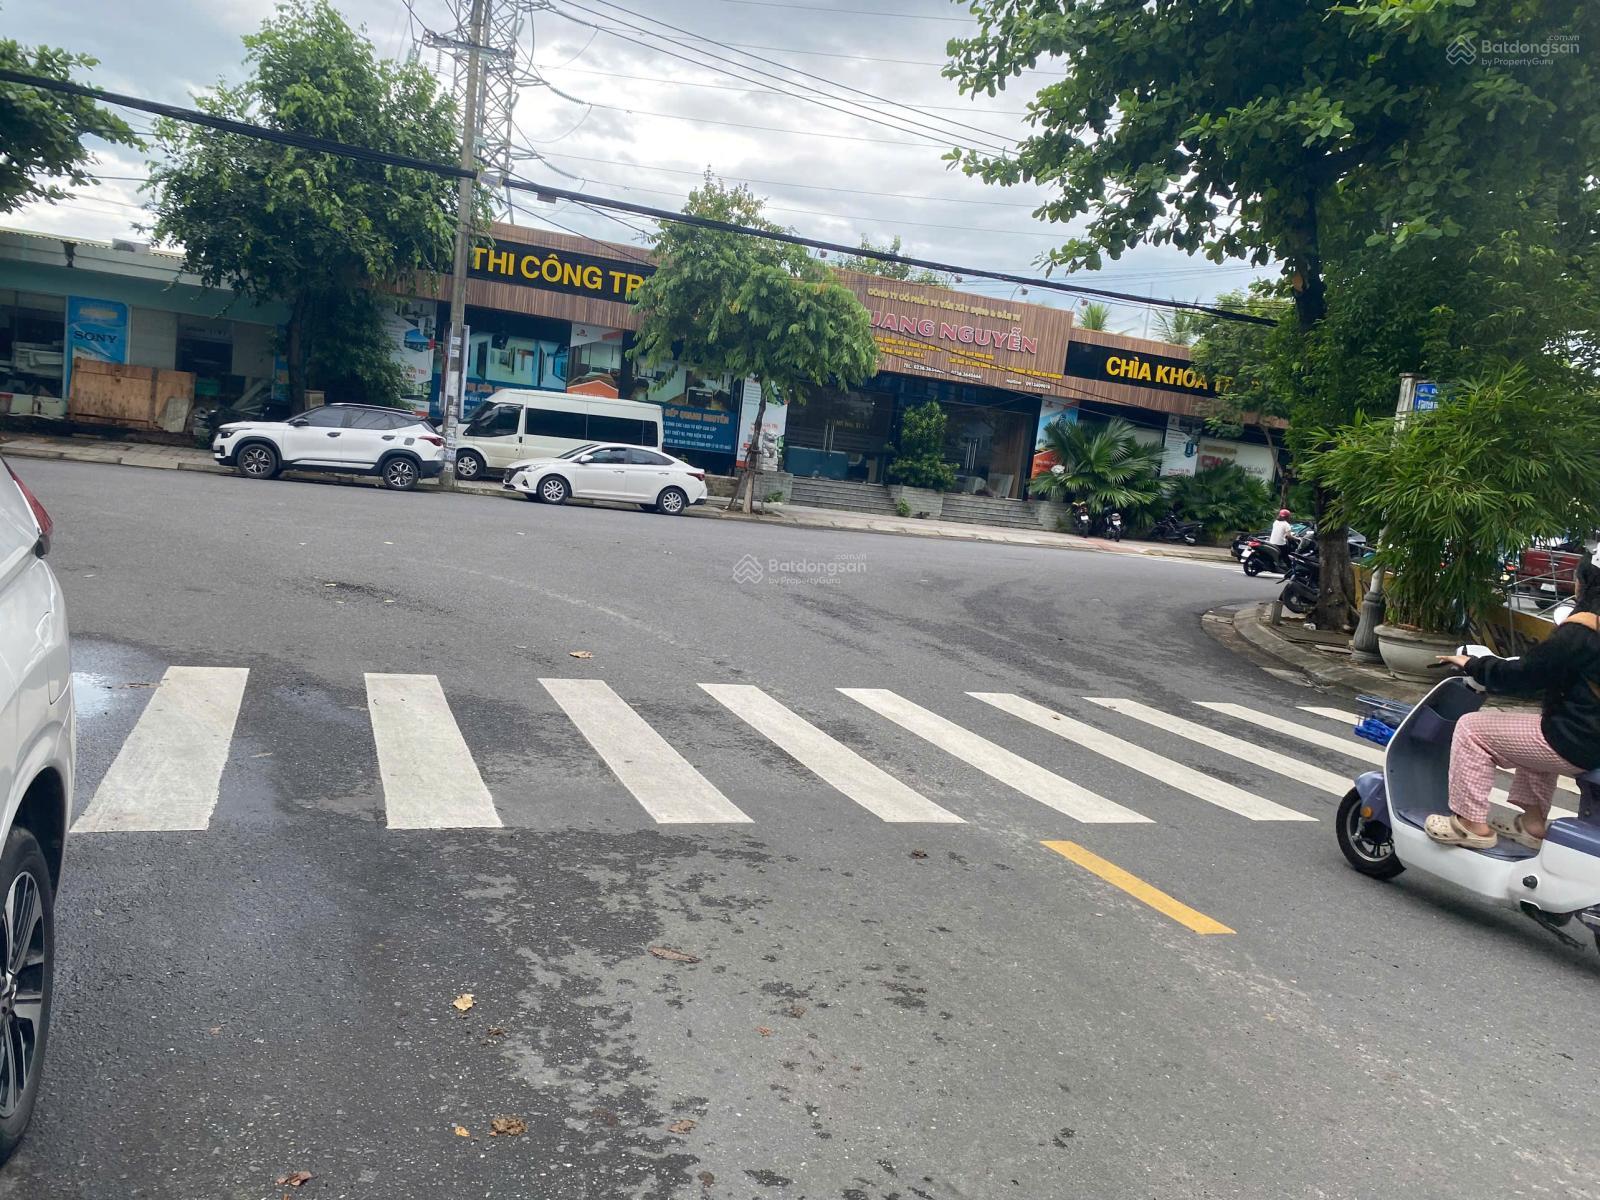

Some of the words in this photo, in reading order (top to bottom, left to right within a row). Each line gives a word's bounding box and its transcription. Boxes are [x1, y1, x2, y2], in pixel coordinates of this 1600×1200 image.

[473, 247, 515, 276] THI
[520, 253, 603, 290] CÔNG
[608, 270, 646, 298] TR
[73, 330, 118, 344] SONY
[869, 311, 935, 337] UANG
[939, 322, 1039, 354] NGUYỄN
[1106, 356, 1152, 381] CHÌA
